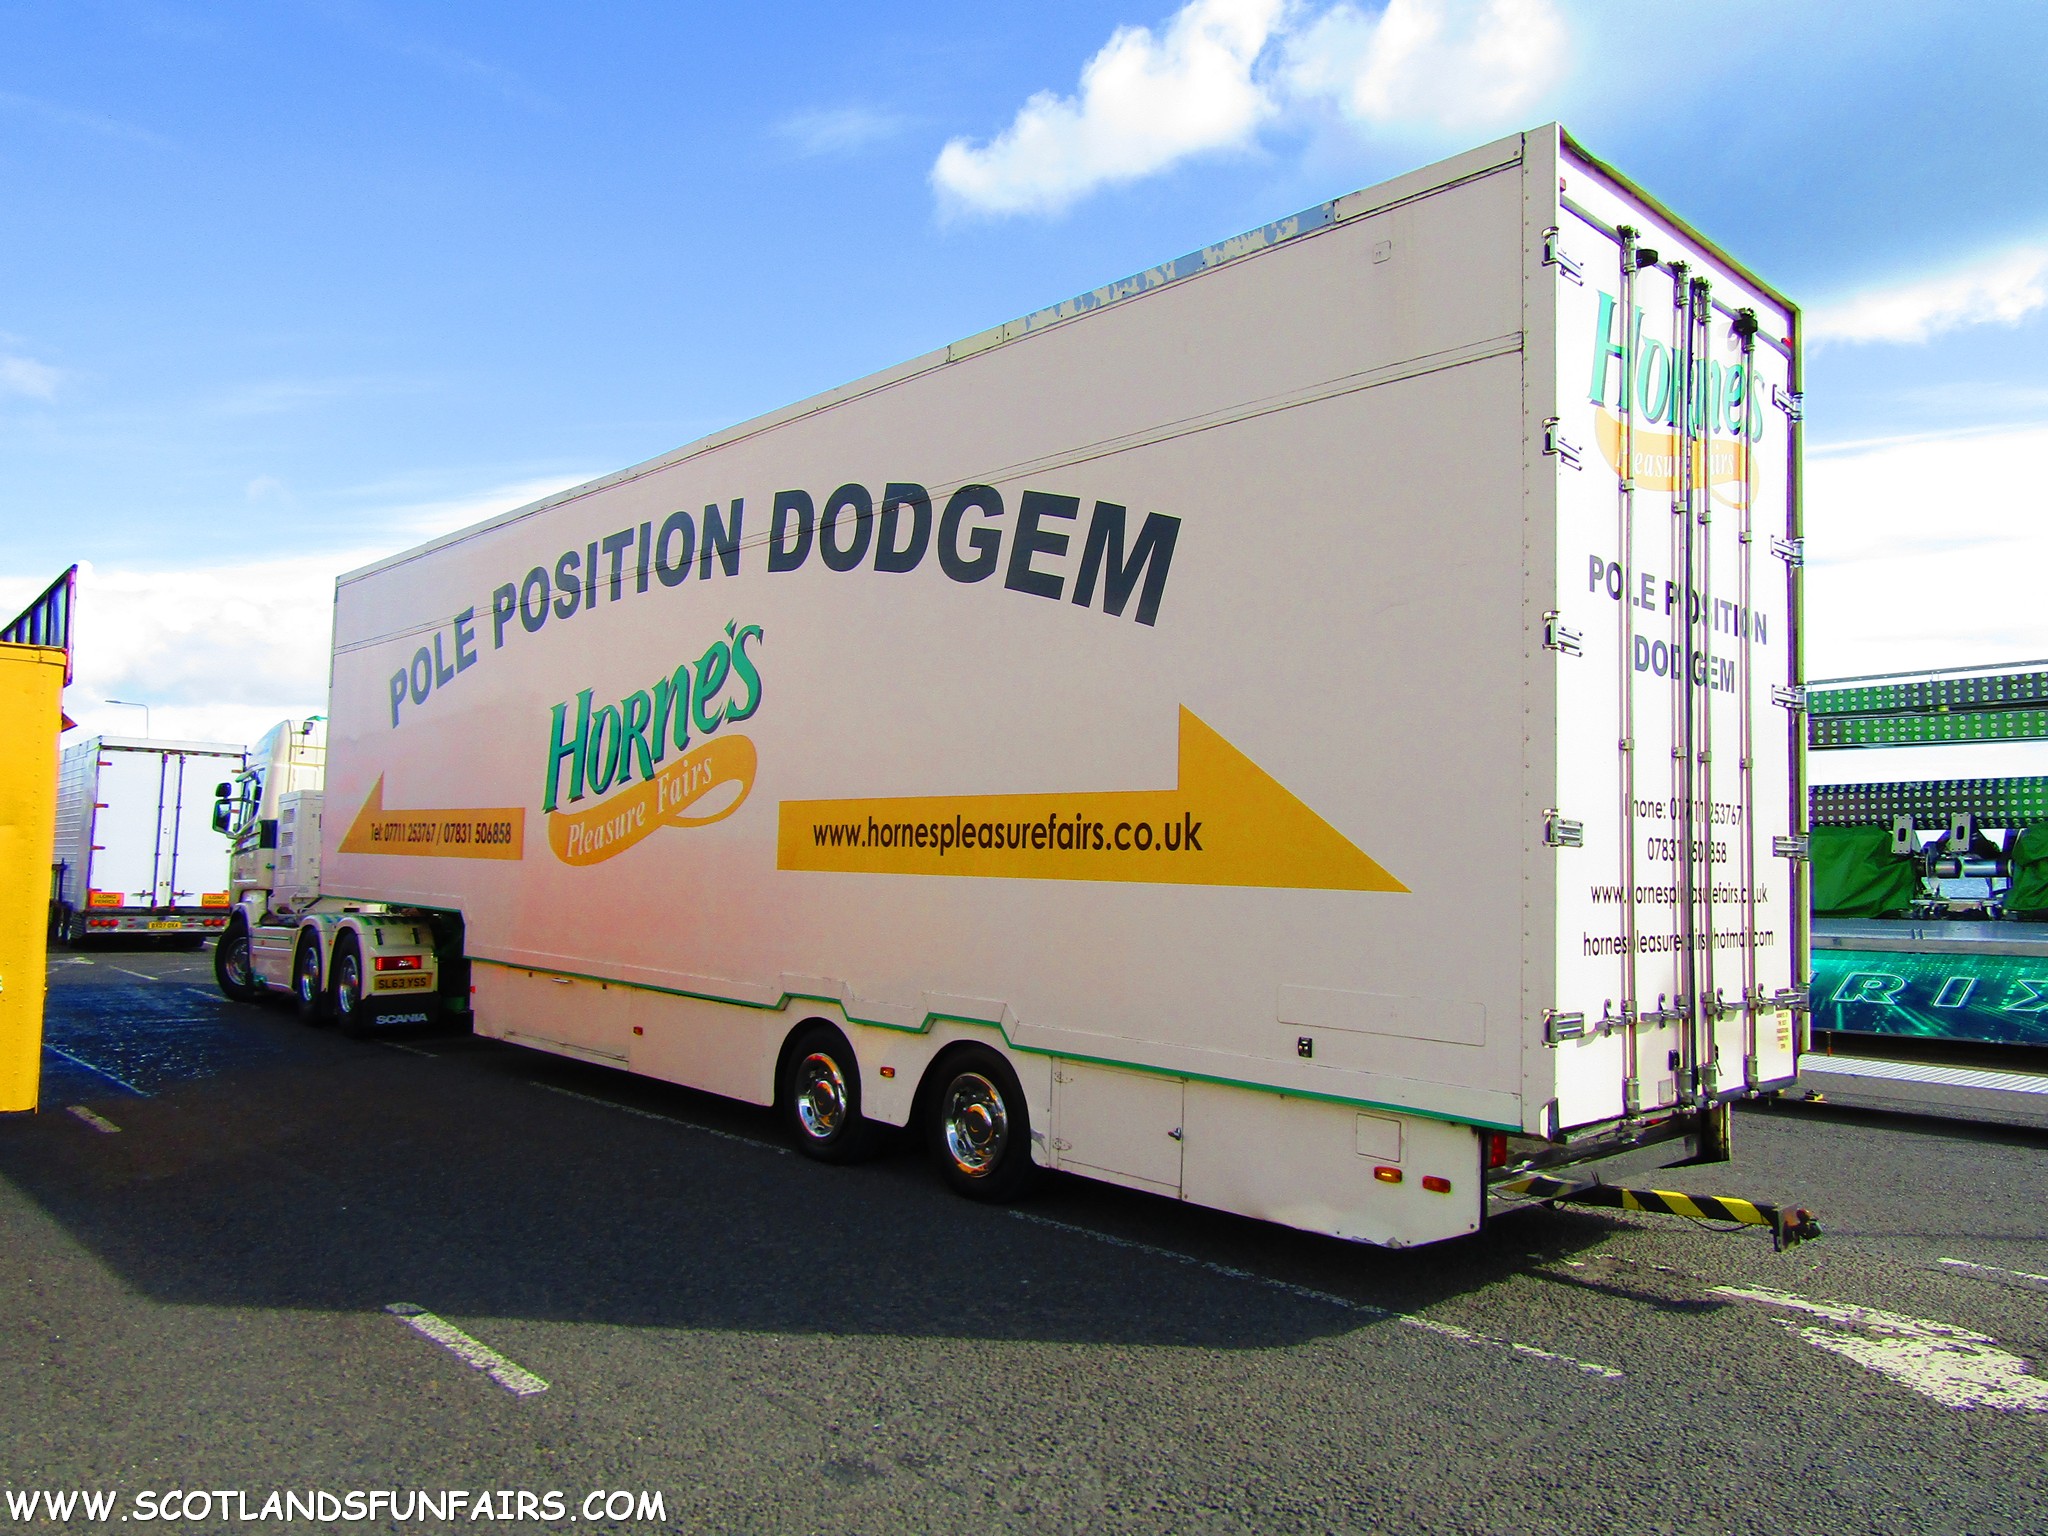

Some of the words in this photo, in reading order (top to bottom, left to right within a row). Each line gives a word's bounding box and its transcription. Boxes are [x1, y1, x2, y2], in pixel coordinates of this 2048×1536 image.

[389, 605, 478, 729] POLE
[493, 498, 744, 650] POSITION
[767, 483, 1182, 627] DODGEM
[566, 801, 646, 858] Pleasure
[656, 758, 712, 815] Fairs
[384, 822, 406, 842] 07711
[407, 822, 437, 843] 253767
[444, 822, 472, 844] 07831
[475, 822, 512, 844] 506858
[813, 811, 1204, 856] www.hornespleasurefairs.co.uk
[378, 979, 404, 989] SL63
[408, 977, 426, 987] YSS
[375, 1013, 429, 1025] SCANIA
